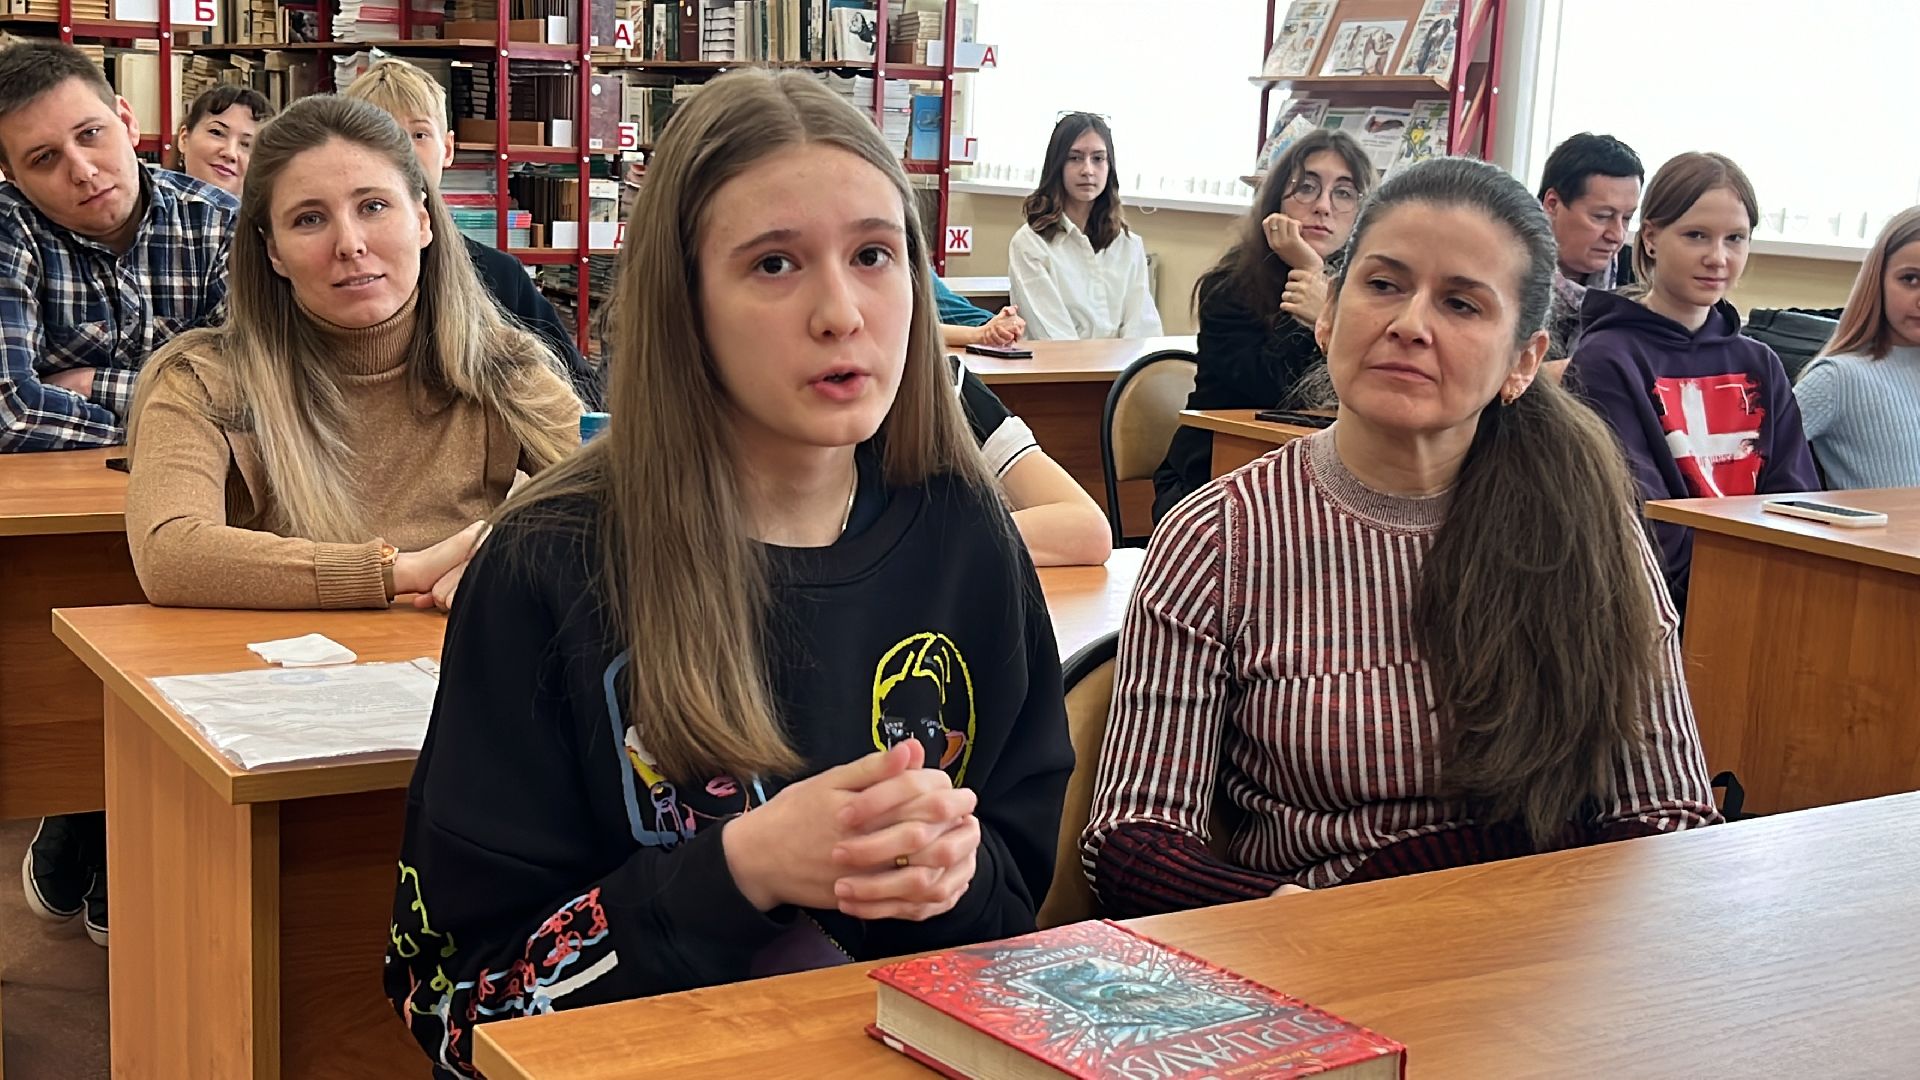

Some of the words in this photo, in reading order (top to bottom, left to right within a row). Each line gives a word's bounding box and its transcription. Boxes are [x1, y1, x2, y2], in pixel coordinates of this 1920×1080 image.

[195, 0, 215, 22] Б
[615, 23, 631, 46] А
[980, 46, 997, 67] А
[618, 126, 635, 147] Б
[964, 137, 977, 157] Г
[949, 229, 969, 249] Ж
[1105, 1013, 1345, 1080] ЗЕРЦАЛИЯ
